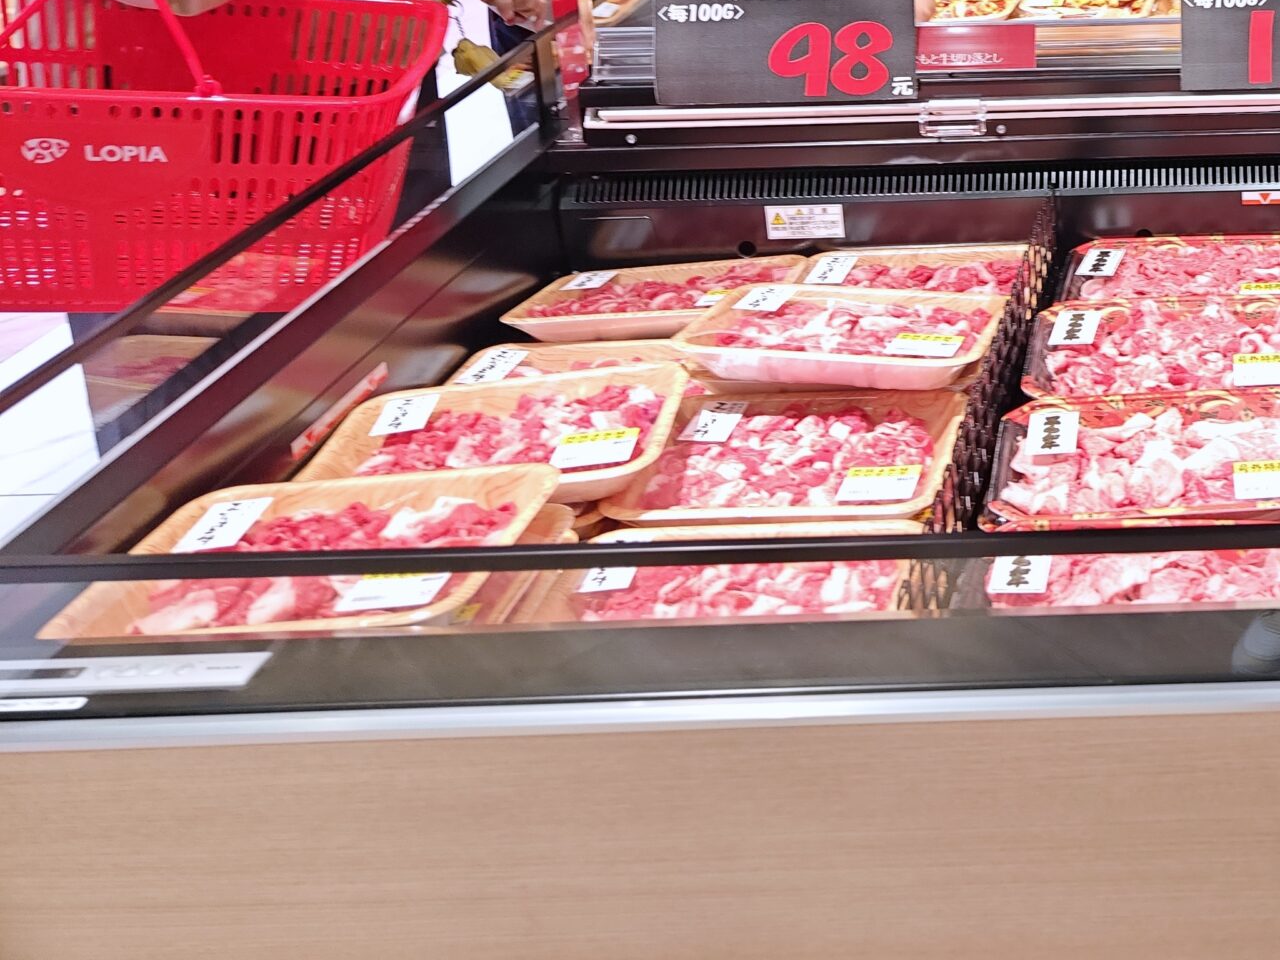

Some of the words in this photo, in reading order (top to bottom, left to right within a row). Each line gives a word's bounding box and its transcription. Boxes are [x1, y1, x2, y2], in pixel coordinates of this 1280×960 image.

[768, 20, 893, 97] 98
[891, 76, 914, 96] 元
[83, 144, 169, 163] LOPIA
